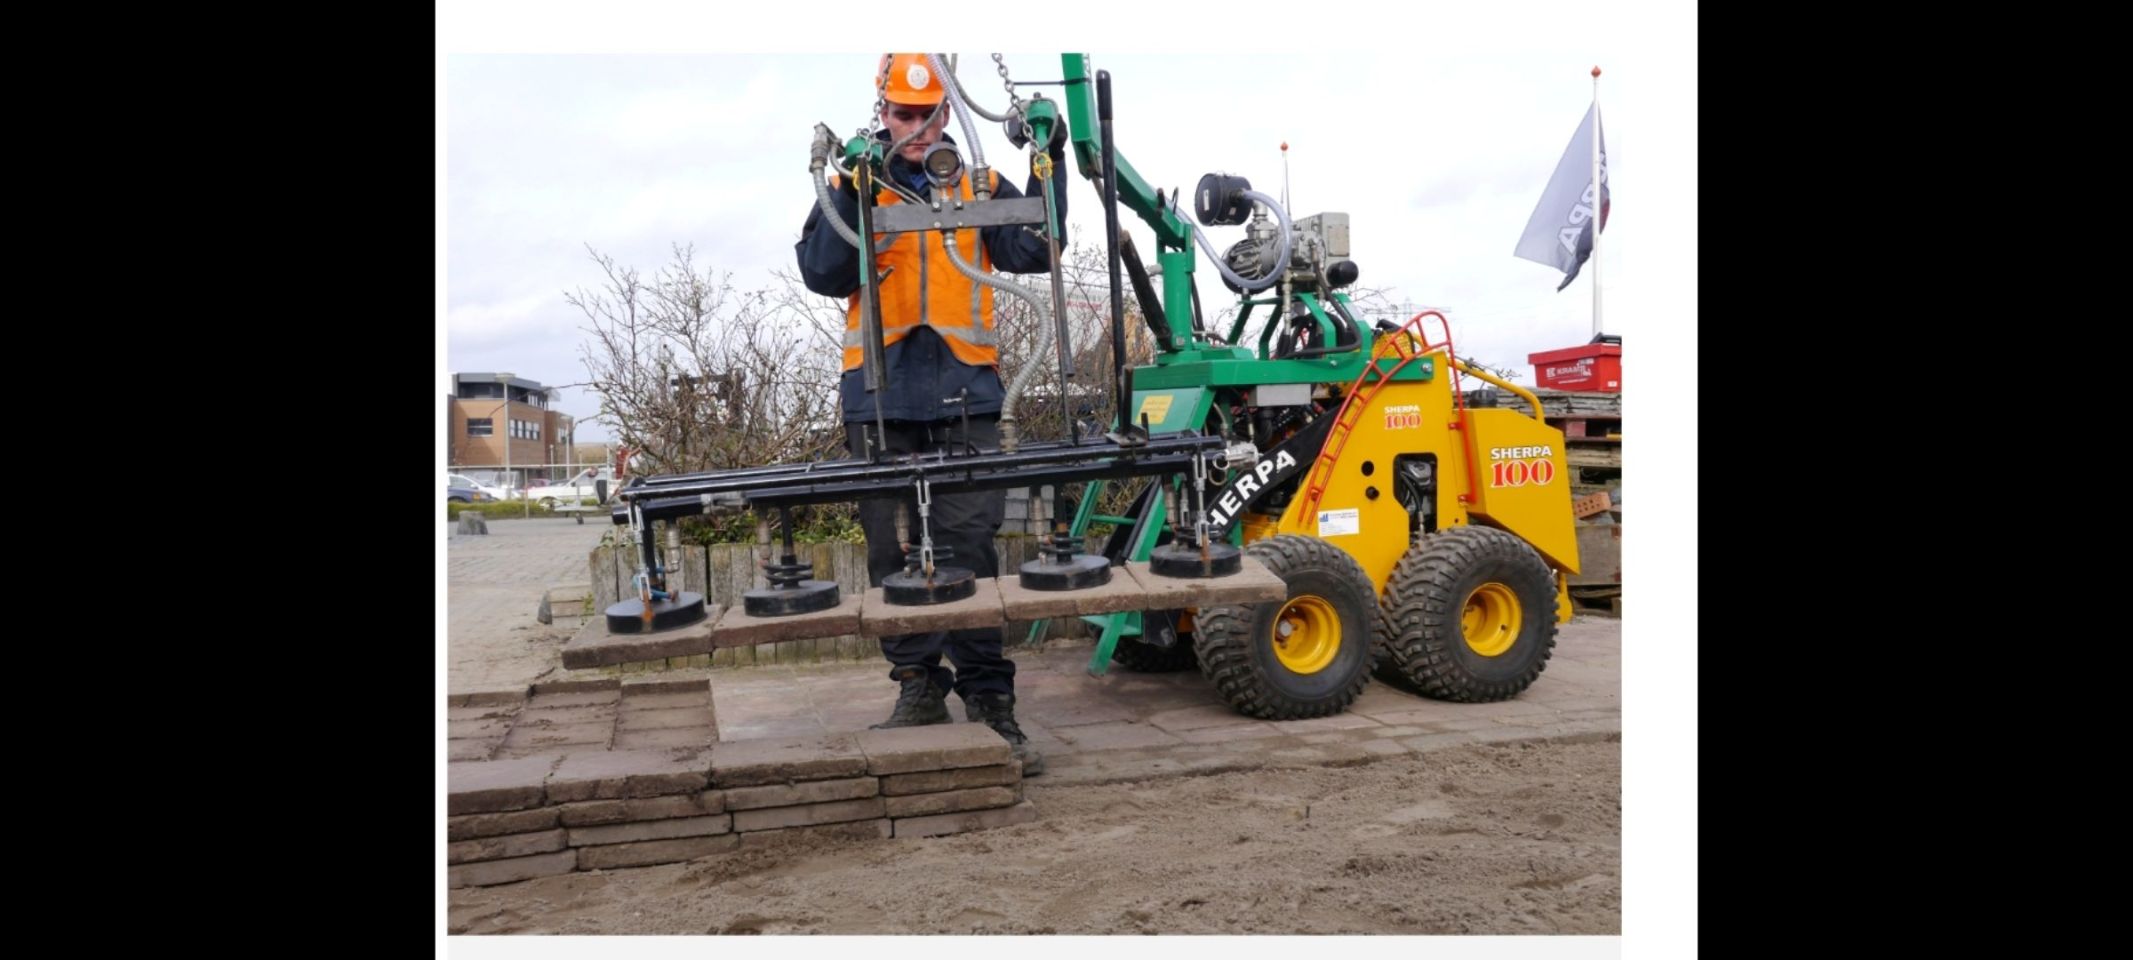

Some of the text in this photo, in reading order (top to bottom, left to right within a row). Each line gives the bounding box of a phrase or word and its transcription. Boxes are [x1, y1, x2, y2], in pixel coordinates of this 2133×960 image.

[1384, 405, 1420, 414] SHERPA
[1384, 413, 1422, 430] 100
[1490, 445, 1552, 460] SHERPA
[1490, 458, 1554, 488] 100
[1206, 450, 1296, 527] HERPA
